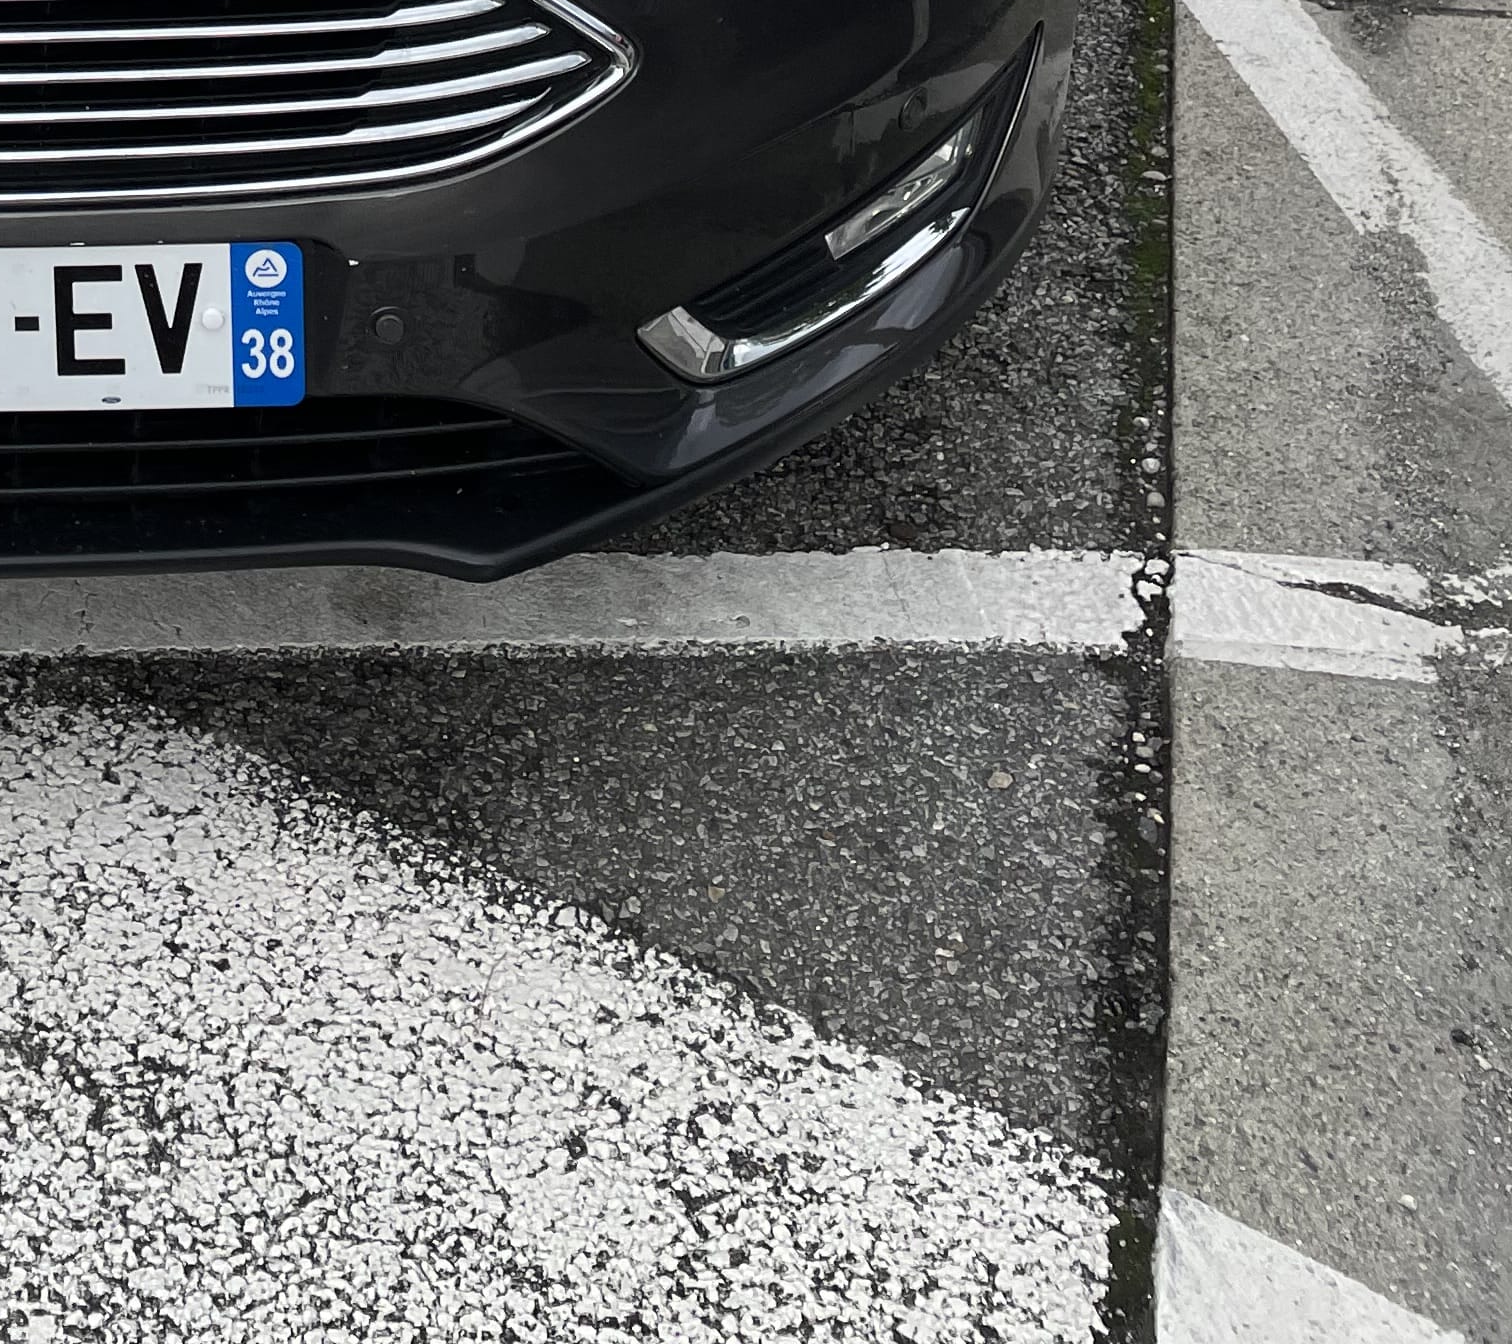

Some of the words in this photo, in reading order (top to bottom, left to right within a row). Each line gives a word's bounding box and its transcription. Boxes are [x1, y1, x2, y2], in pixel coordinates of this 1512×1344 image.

[247, 290, 286, 299] Auvergne
[255, 308, 279, 316] Alpes
[241, 328, 295, 379] 38
